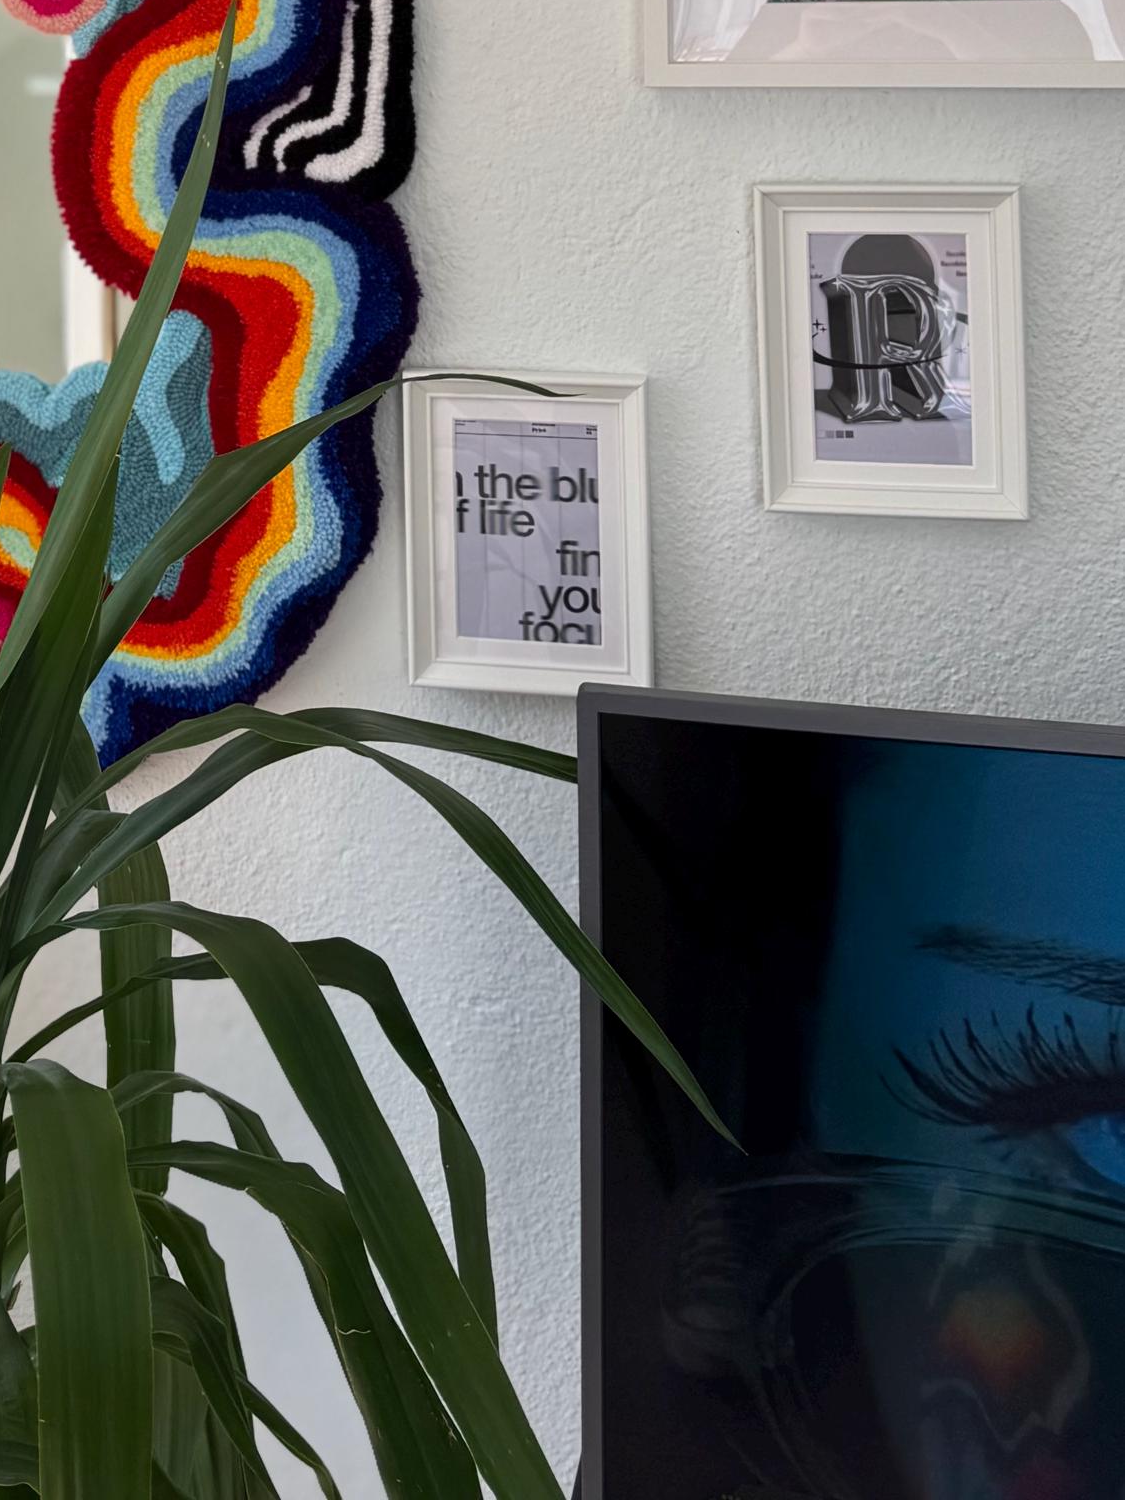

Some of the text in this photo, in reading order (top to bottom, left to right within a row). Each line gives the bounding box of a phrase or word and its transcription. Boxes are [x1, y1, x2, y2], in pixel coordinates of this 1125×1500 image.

[474, 464, 542, 501] the
[479, 499, 535, 537] life
[556, 540, 601, 577] fin
